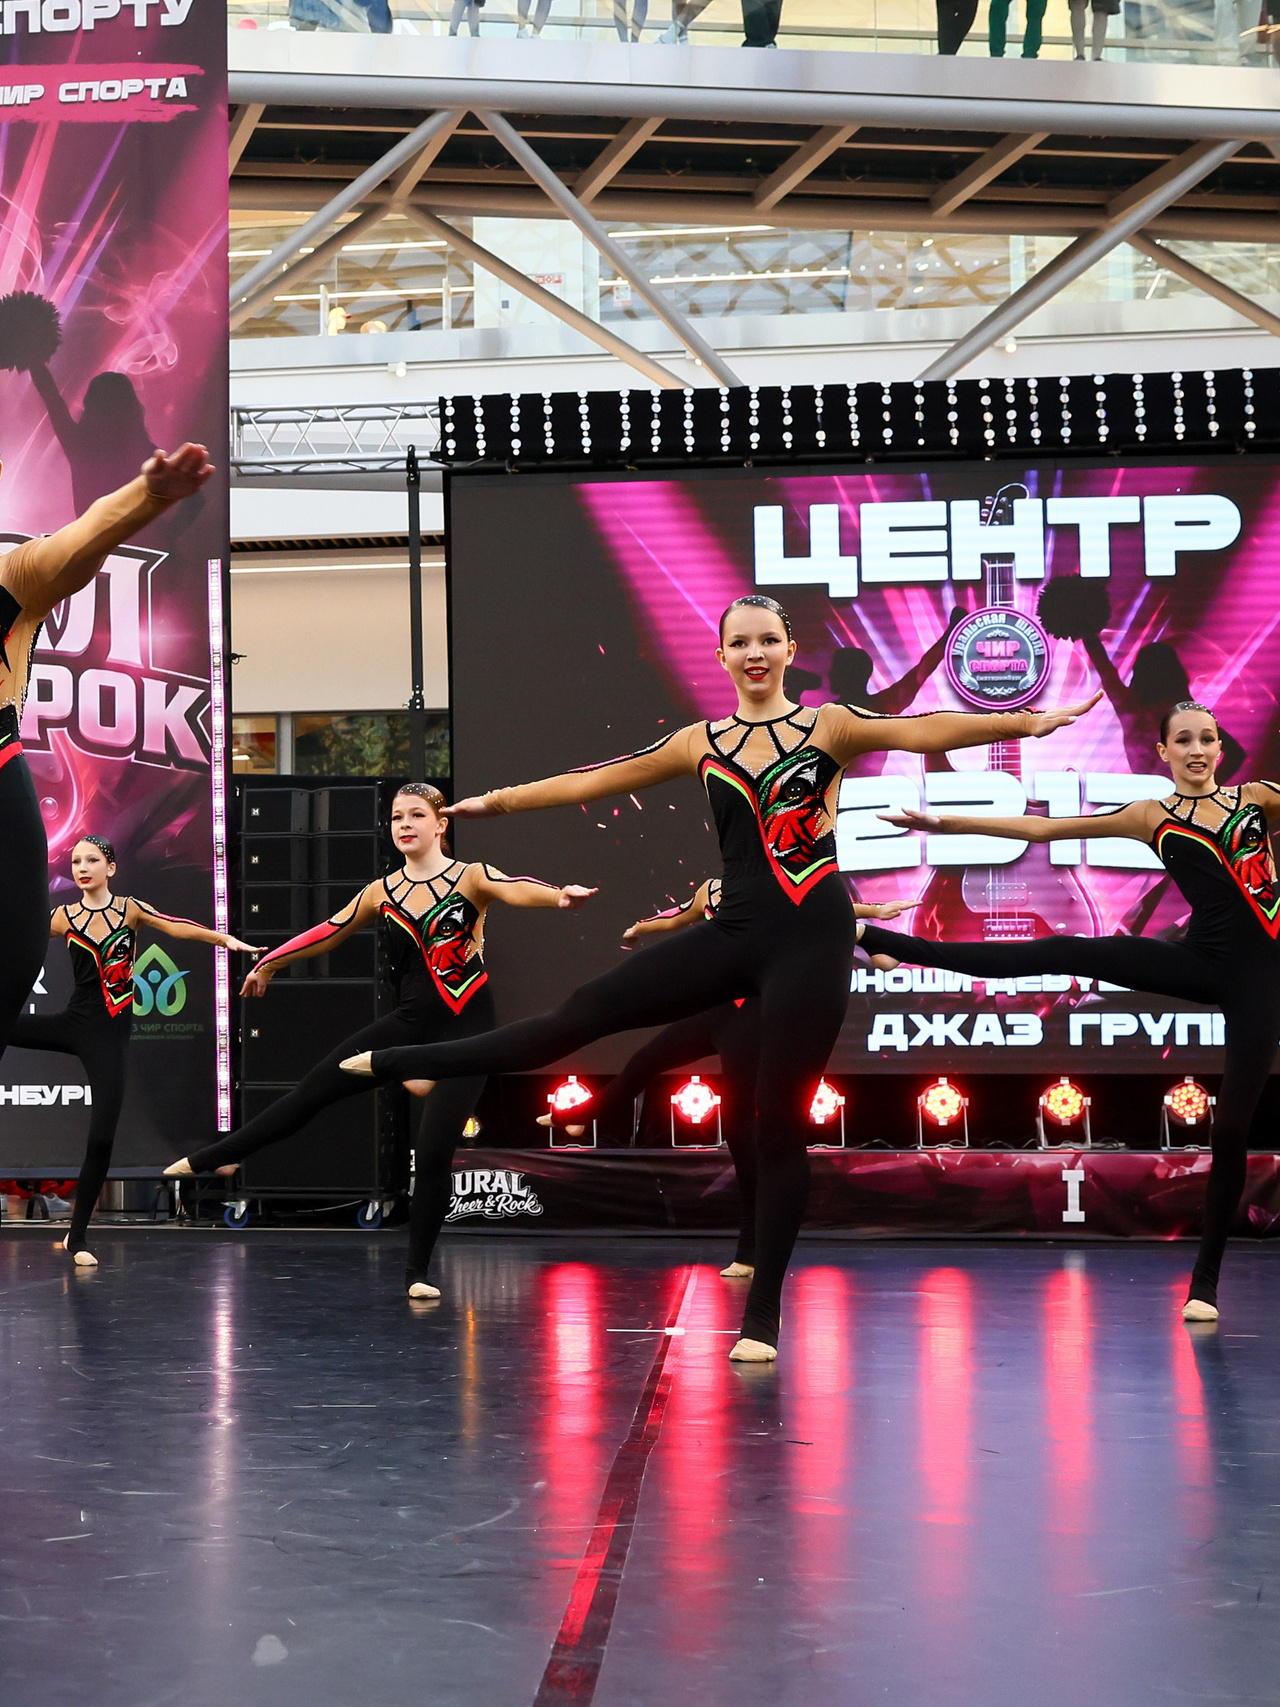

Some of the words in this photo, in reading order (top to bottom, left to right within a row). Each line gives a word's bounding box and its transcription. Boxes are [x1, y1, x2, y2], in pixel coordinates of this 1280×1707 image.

[58, 77, 188, 103] СПОРТА
[753, 494, 1242, 598] ЦЕНТР
[975, 640, 1021, 658] ЧИР
[969, 659, 1028, 672] СПОРТА
[867, 1013, 1044, 1052] ДЖАЗ
[453, 1170, 528, 1198] URAL
[495, 1194, 541, 1214] Rock
